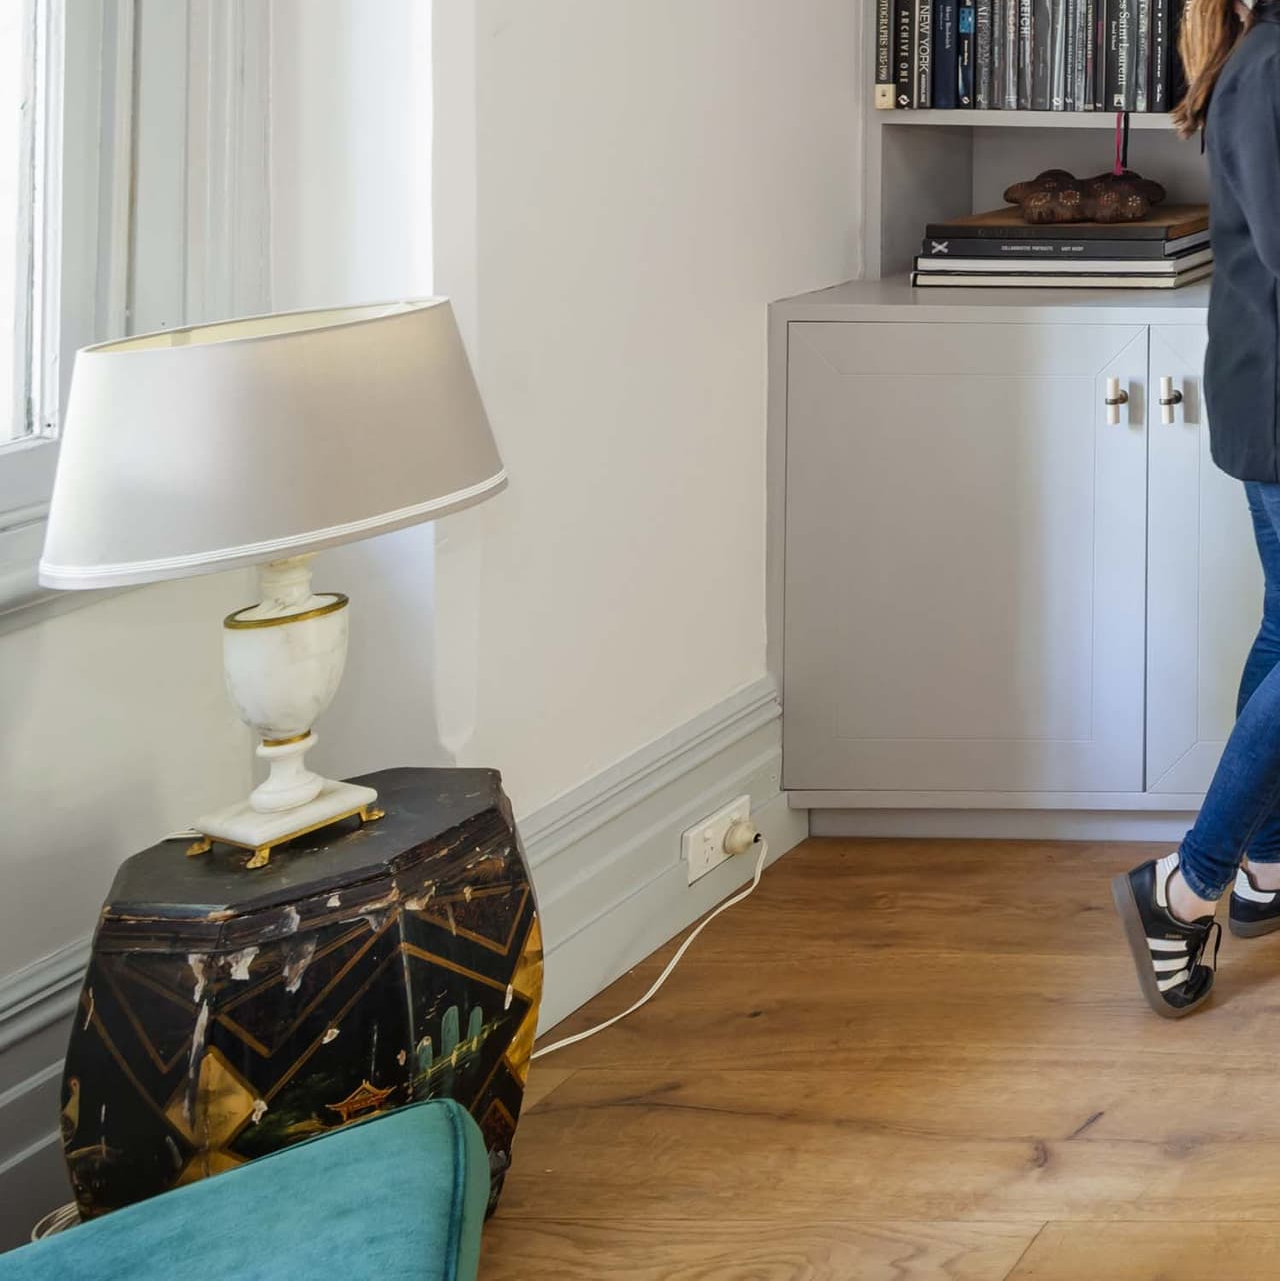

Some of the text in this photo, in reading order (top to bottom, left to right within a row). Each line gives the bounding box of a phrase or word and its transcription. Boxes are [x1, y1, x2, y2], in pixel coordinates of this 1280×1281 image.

[899, 10, 910, 58] ARCHIVE
[920, 5, 931, 35] NEW
[1118, 11, 1130, 41] Saint
[919, 36, 931, 73] YORK
[1118, 42, 1130, 86] Laurent
[899, 62, 909, 85] ONE
